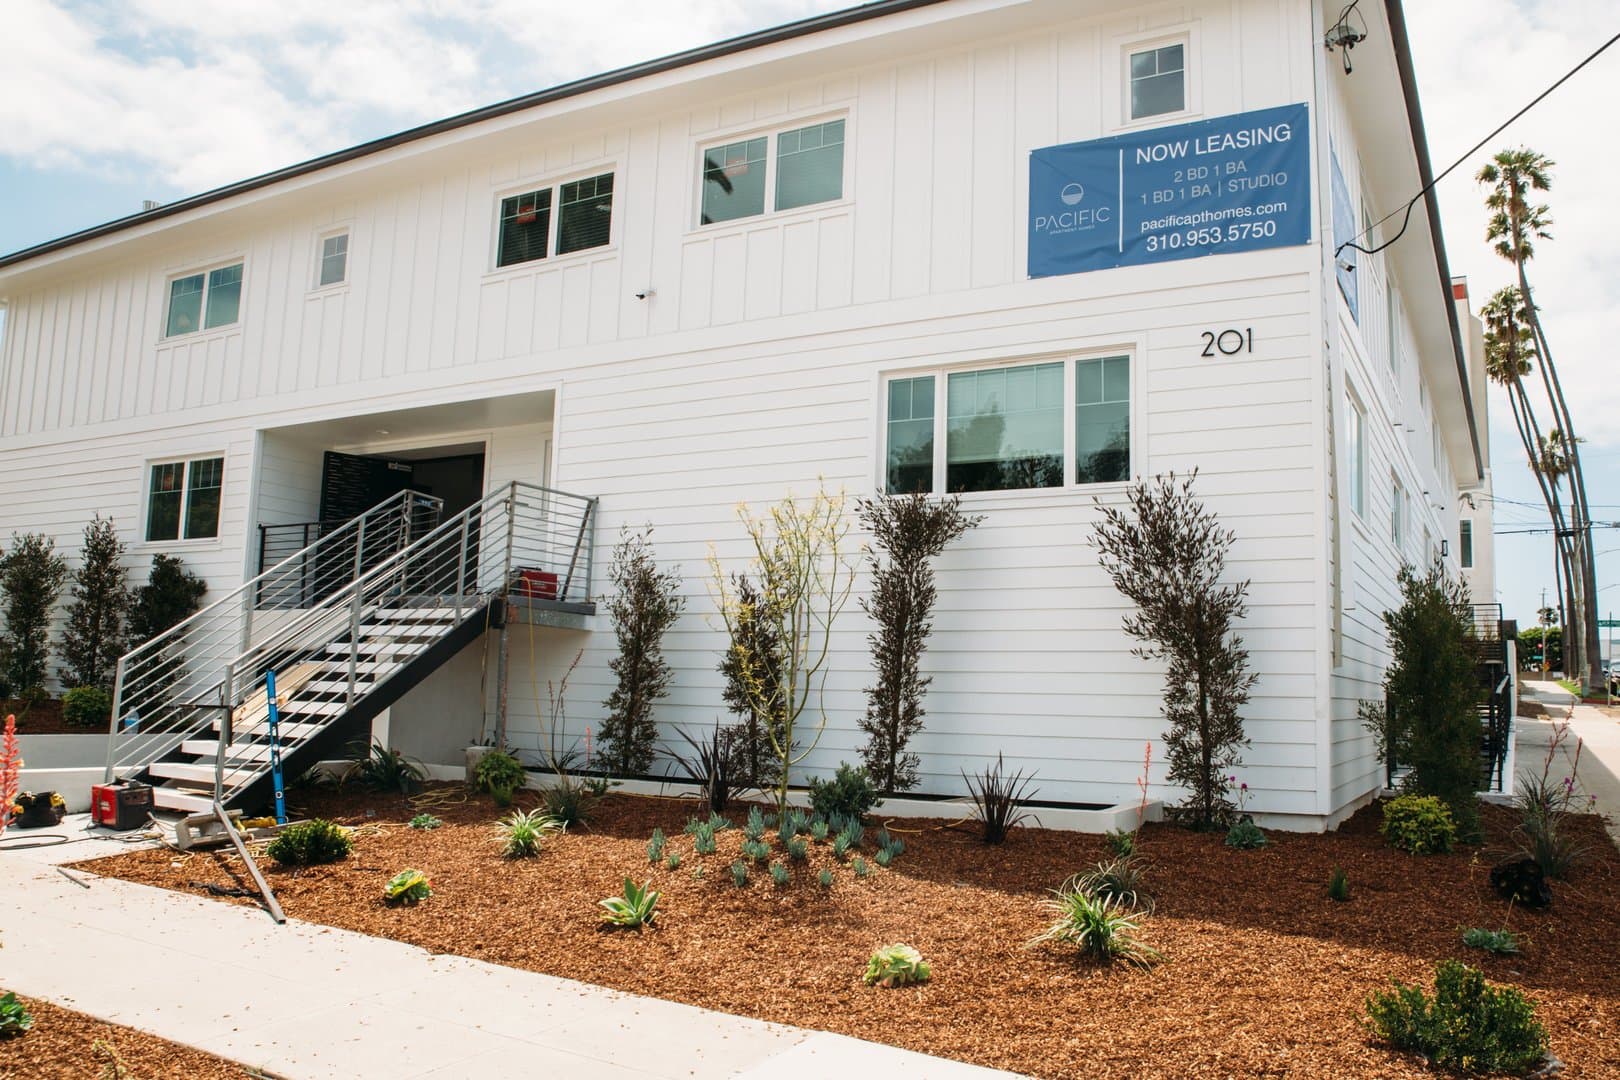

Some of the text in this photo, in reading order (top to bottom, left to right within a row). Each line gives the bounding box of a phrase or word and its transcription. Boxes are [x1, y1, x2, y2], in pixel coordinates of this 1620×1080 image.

[1136, 123, 1292, 165] NOW LEASING
[1174, 160, 1247, 183] 2 BD 1 BA
[1141, 172, 1288, 205] 1 BD 1 BA STUDIO
[1035, 207, 1111, 232] PACIFIC
[1141, 201, 1287, 233] pacificapthomes.com
[1146, 219, 1277, 252] 310.953.5750
[1201, 328, 1252, 357] 201
